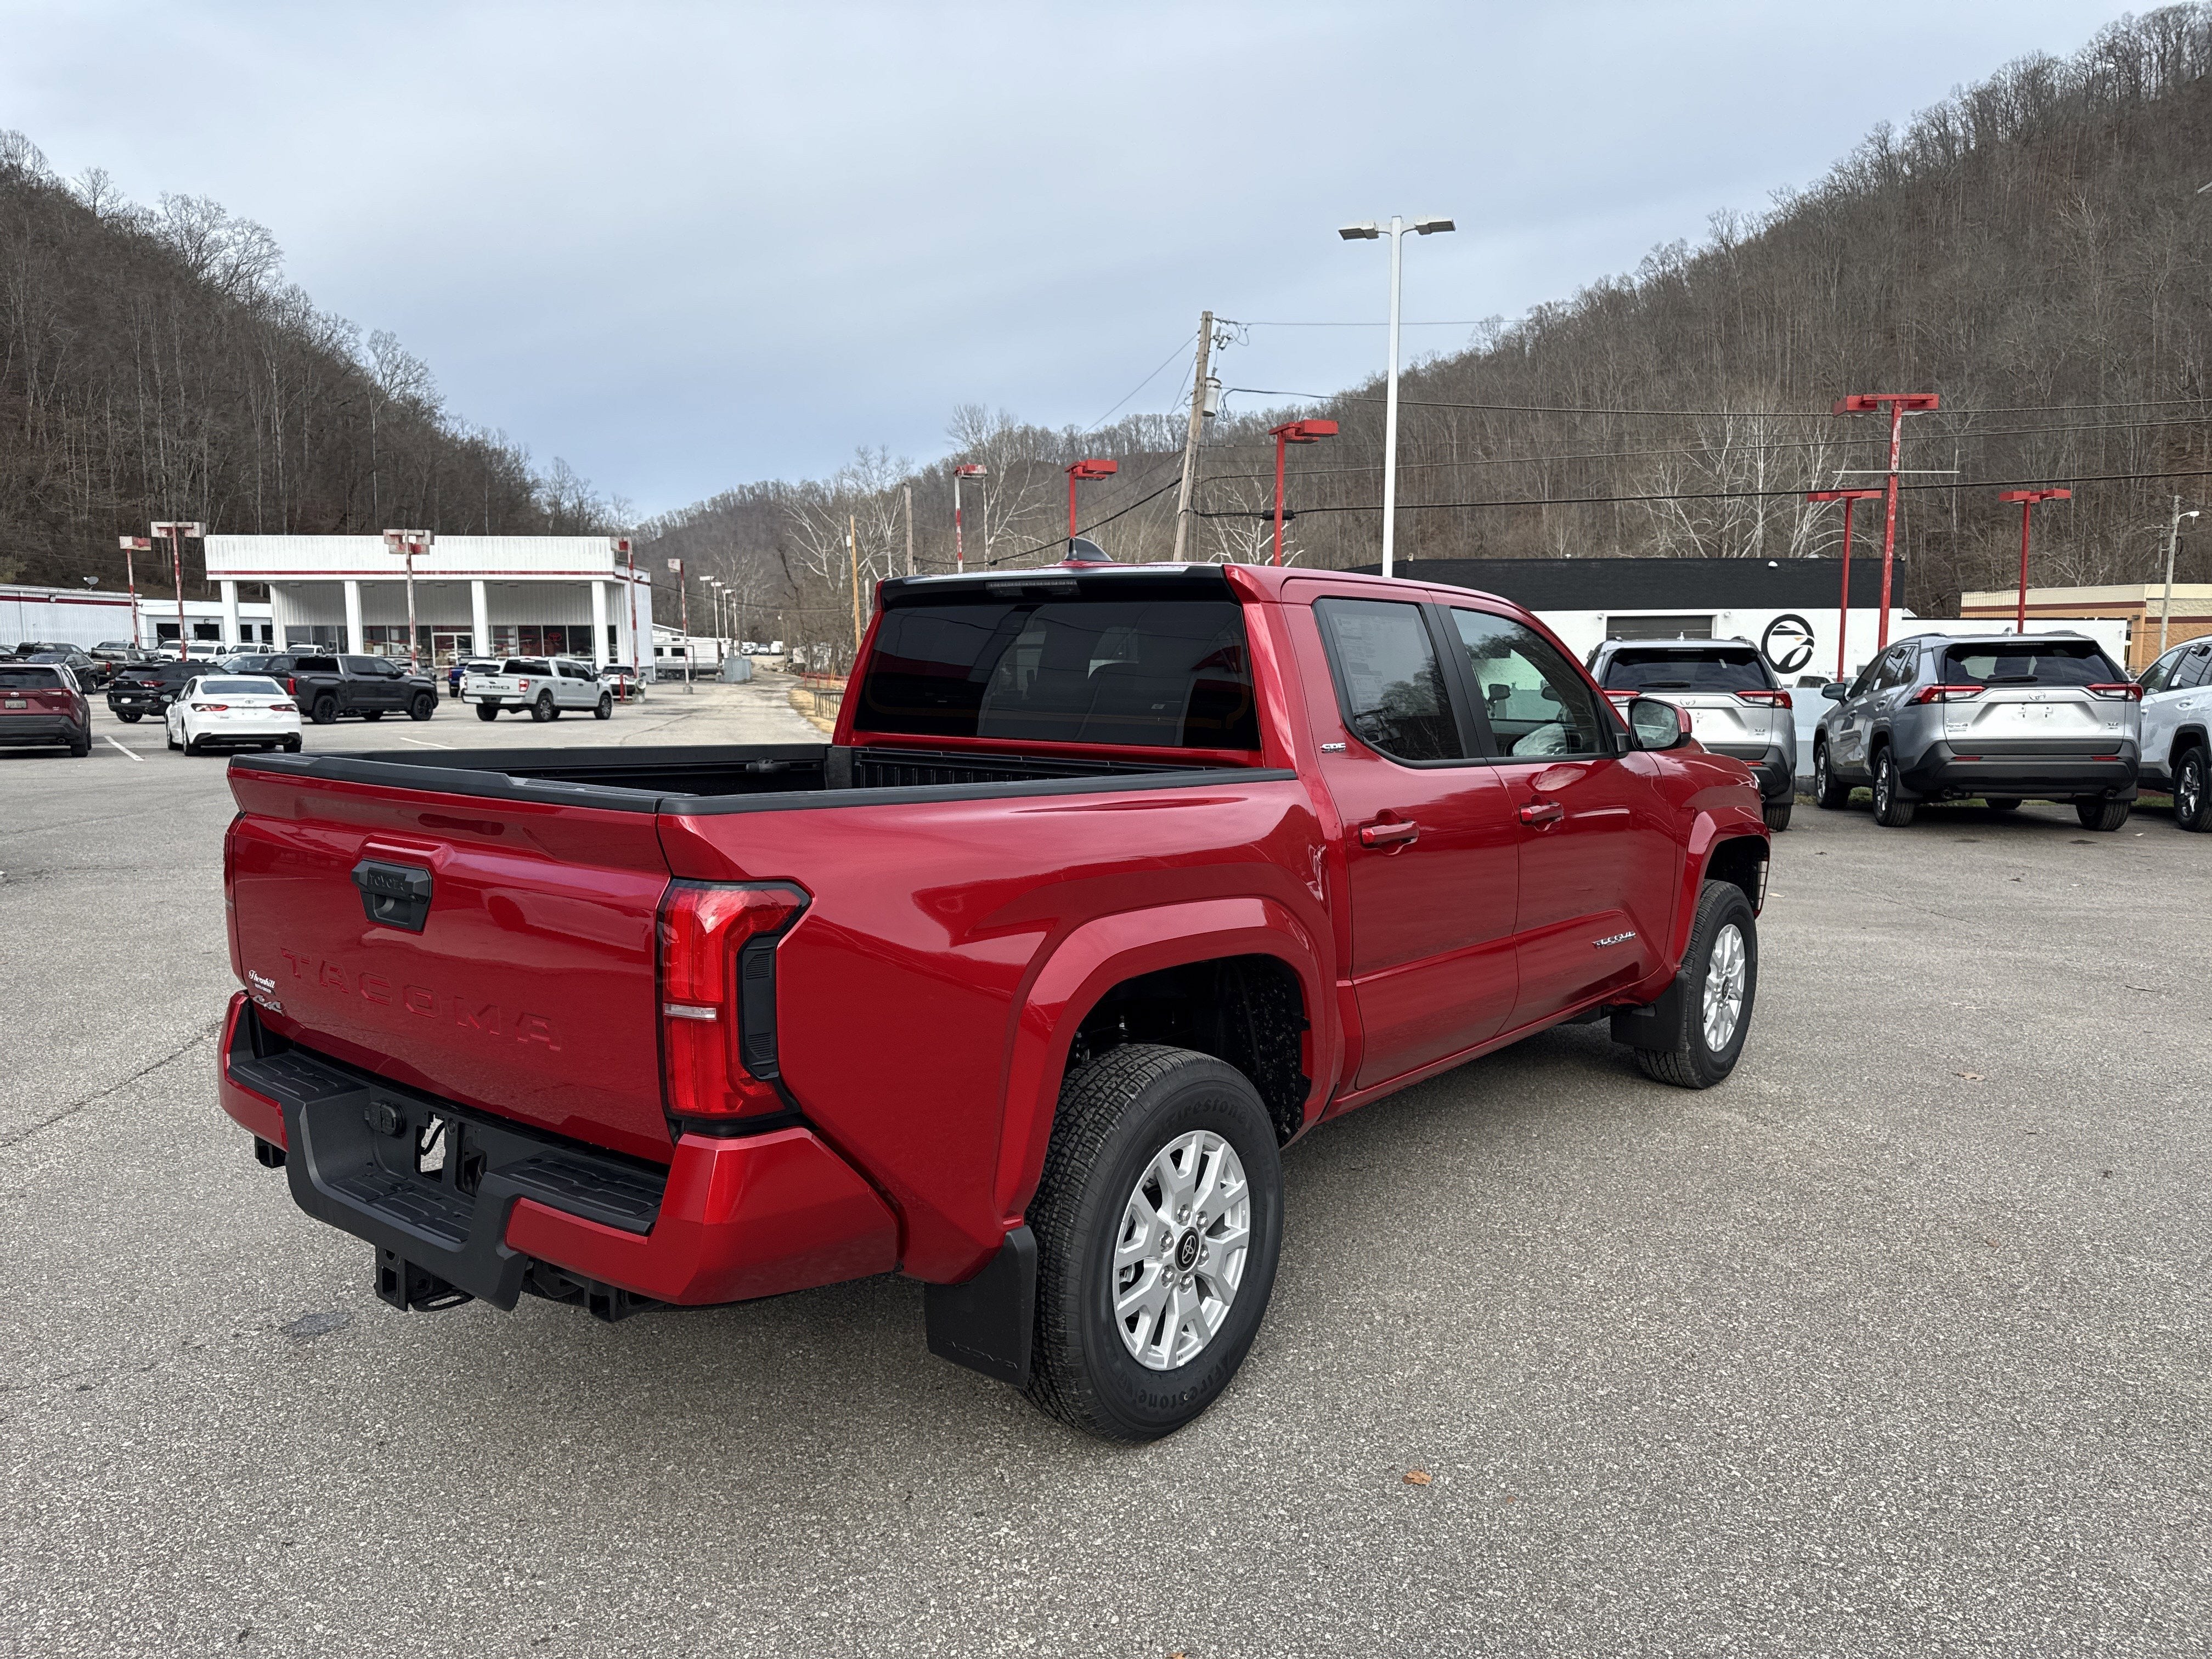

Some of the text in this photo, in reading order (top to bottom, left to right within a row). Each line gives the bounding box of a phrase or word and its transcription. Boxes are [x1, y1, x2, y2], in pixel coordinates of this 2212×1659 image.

[369, 873, 405, 891] TOYOTA
[249, 969, 275, 989] Thornhill
[280, 947, 561, 1052] TACOMA
[1165, 1097, 1248, 1127] Firestone
